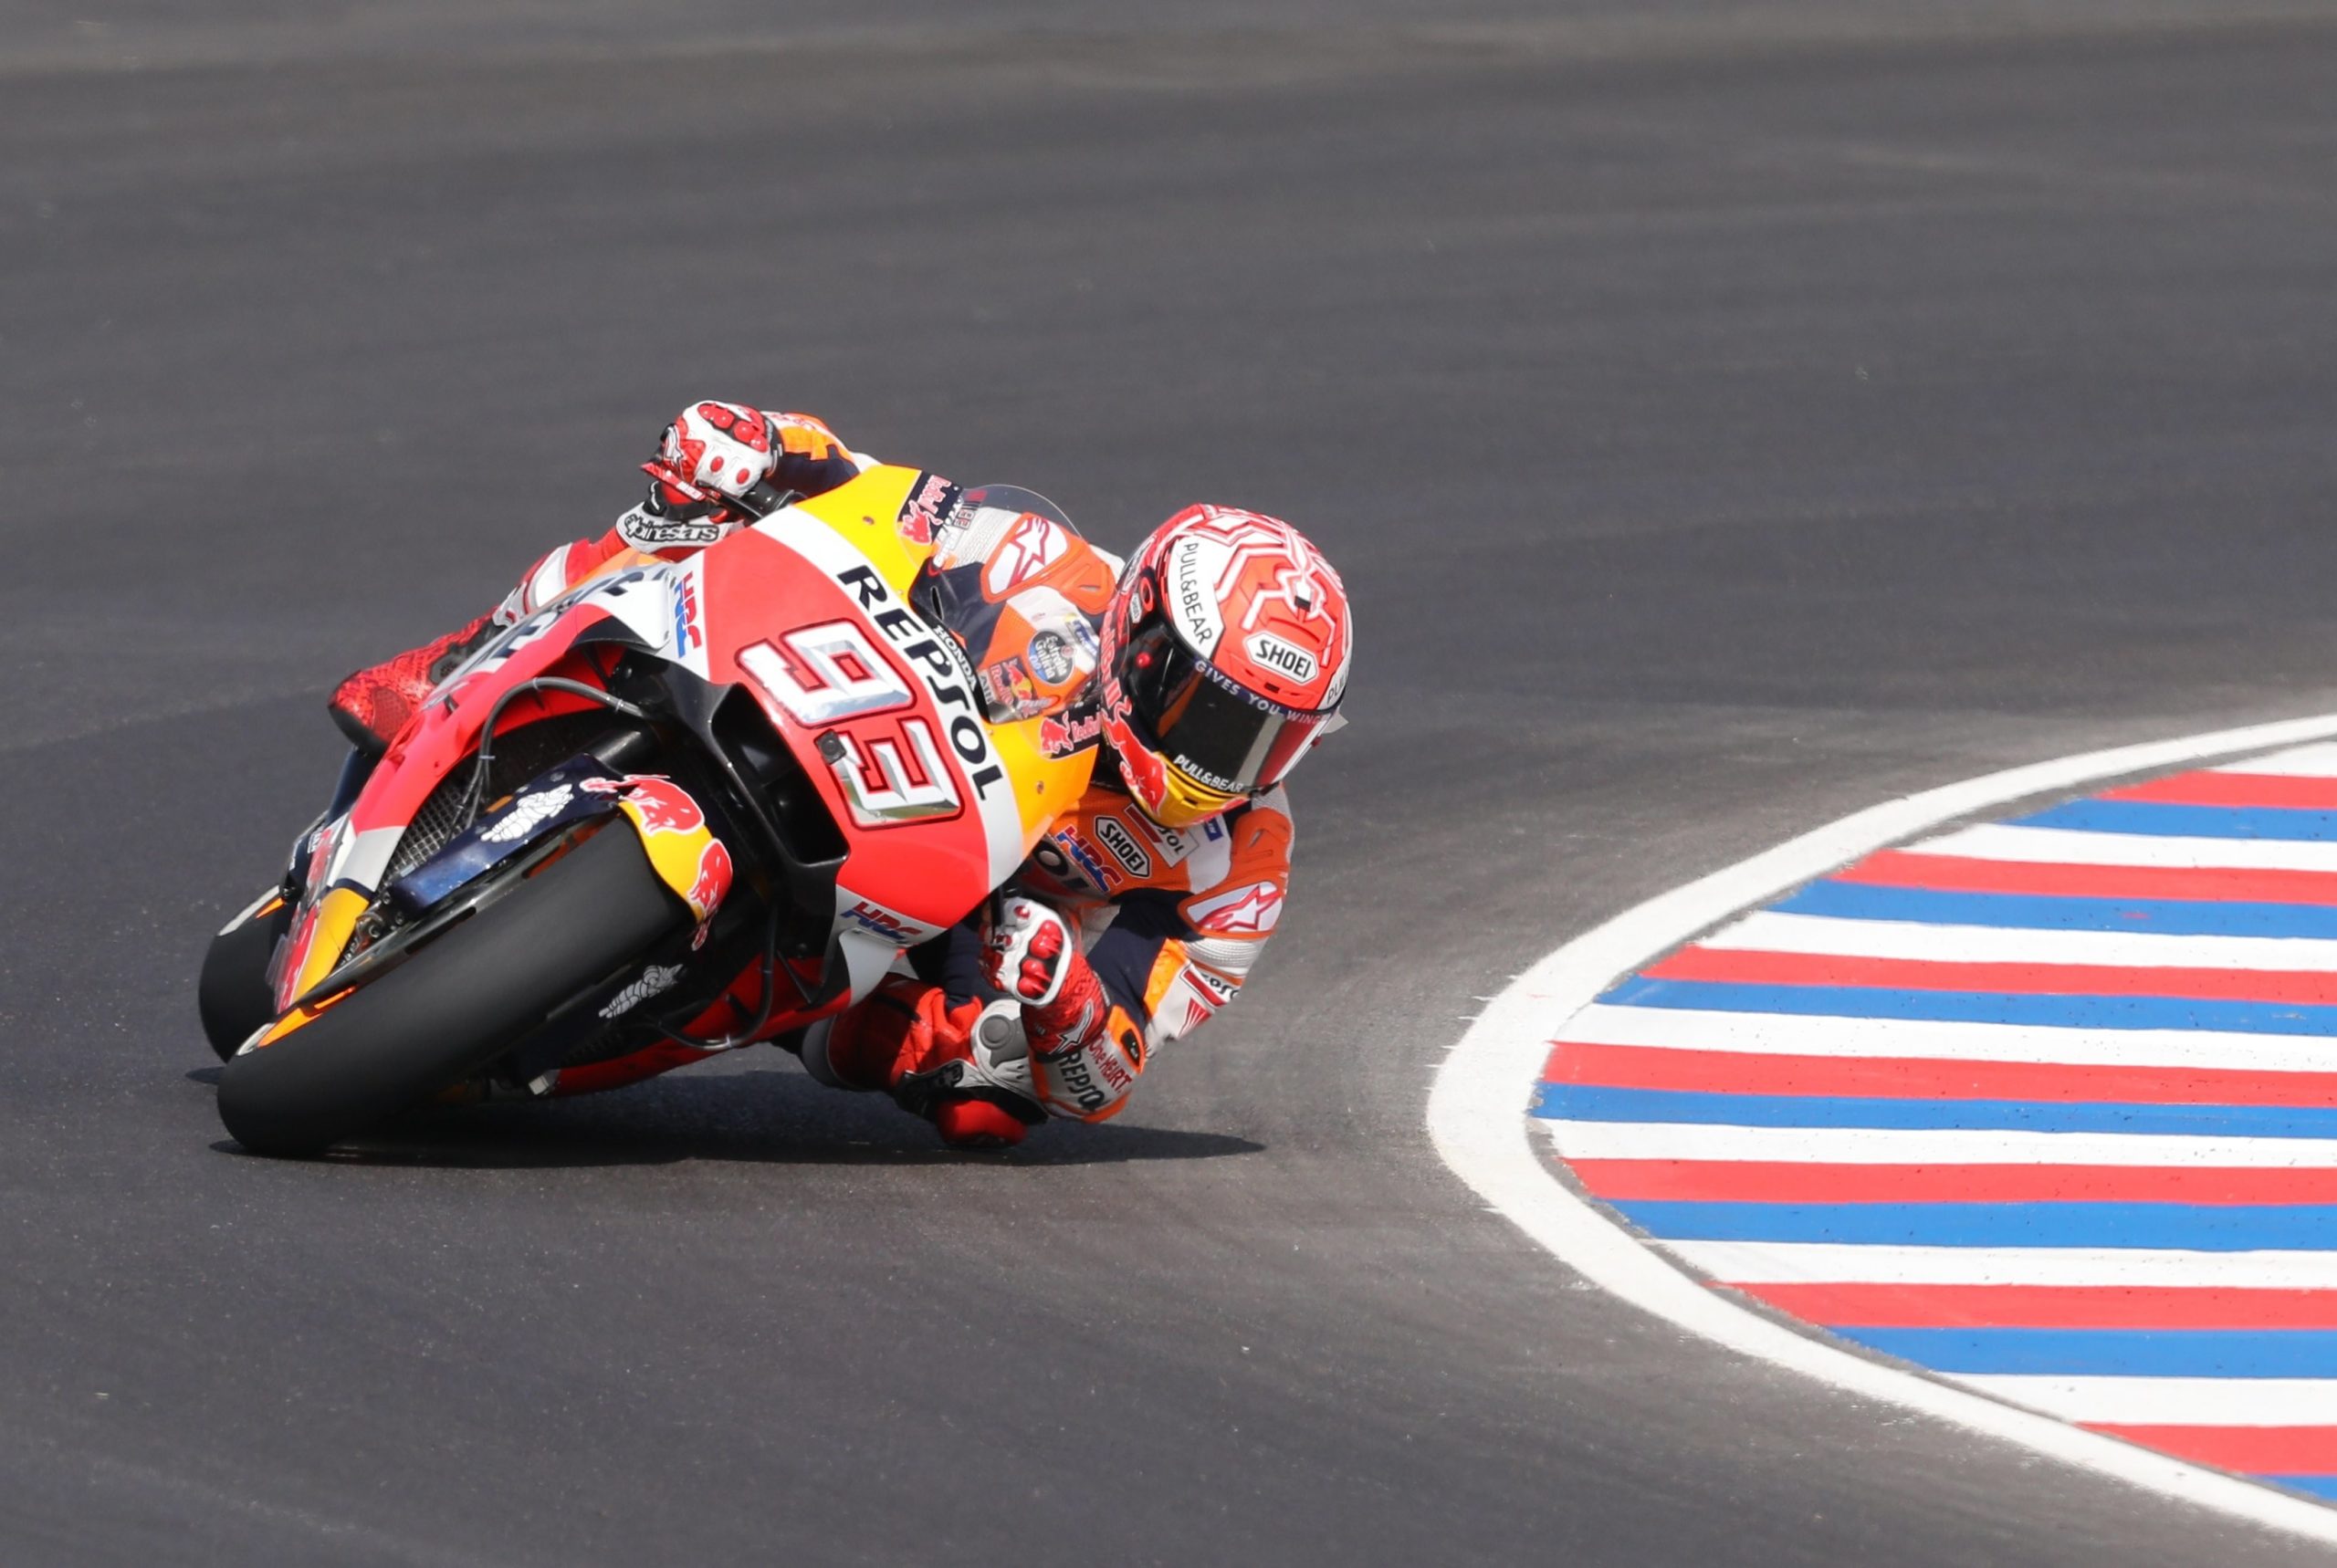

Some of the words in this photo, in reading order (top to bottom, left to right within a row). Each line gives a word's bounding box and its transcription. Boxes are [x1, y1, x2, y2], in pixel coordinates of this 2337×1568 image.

[674, 570, 702, 659] HRC
[1179, 542, 1213, 645] PULL&BEAR
[933, 624, 979, 692] HONDA
[1033, 639, 1056, 680] Galicia
[1043, 634, 1069, 676] Estrella
[1255, 639, 1312, 678] SHOEI
[836, 564, 1003, 801] REPSOL
[1194, 660, 1241, 696] GIVES
[1248, 693, 1282, 716] YOU
[734, 617, 966, 831] 93
[1173, 754, 1243, 792] PULL&BEAR
[1054, 824, 1124, 894] HRC
[1100, 822, 1146, 872] SHOEI
[1157, 826, 1186, 855] SOL
[840, 901, 923, 945] HRC
